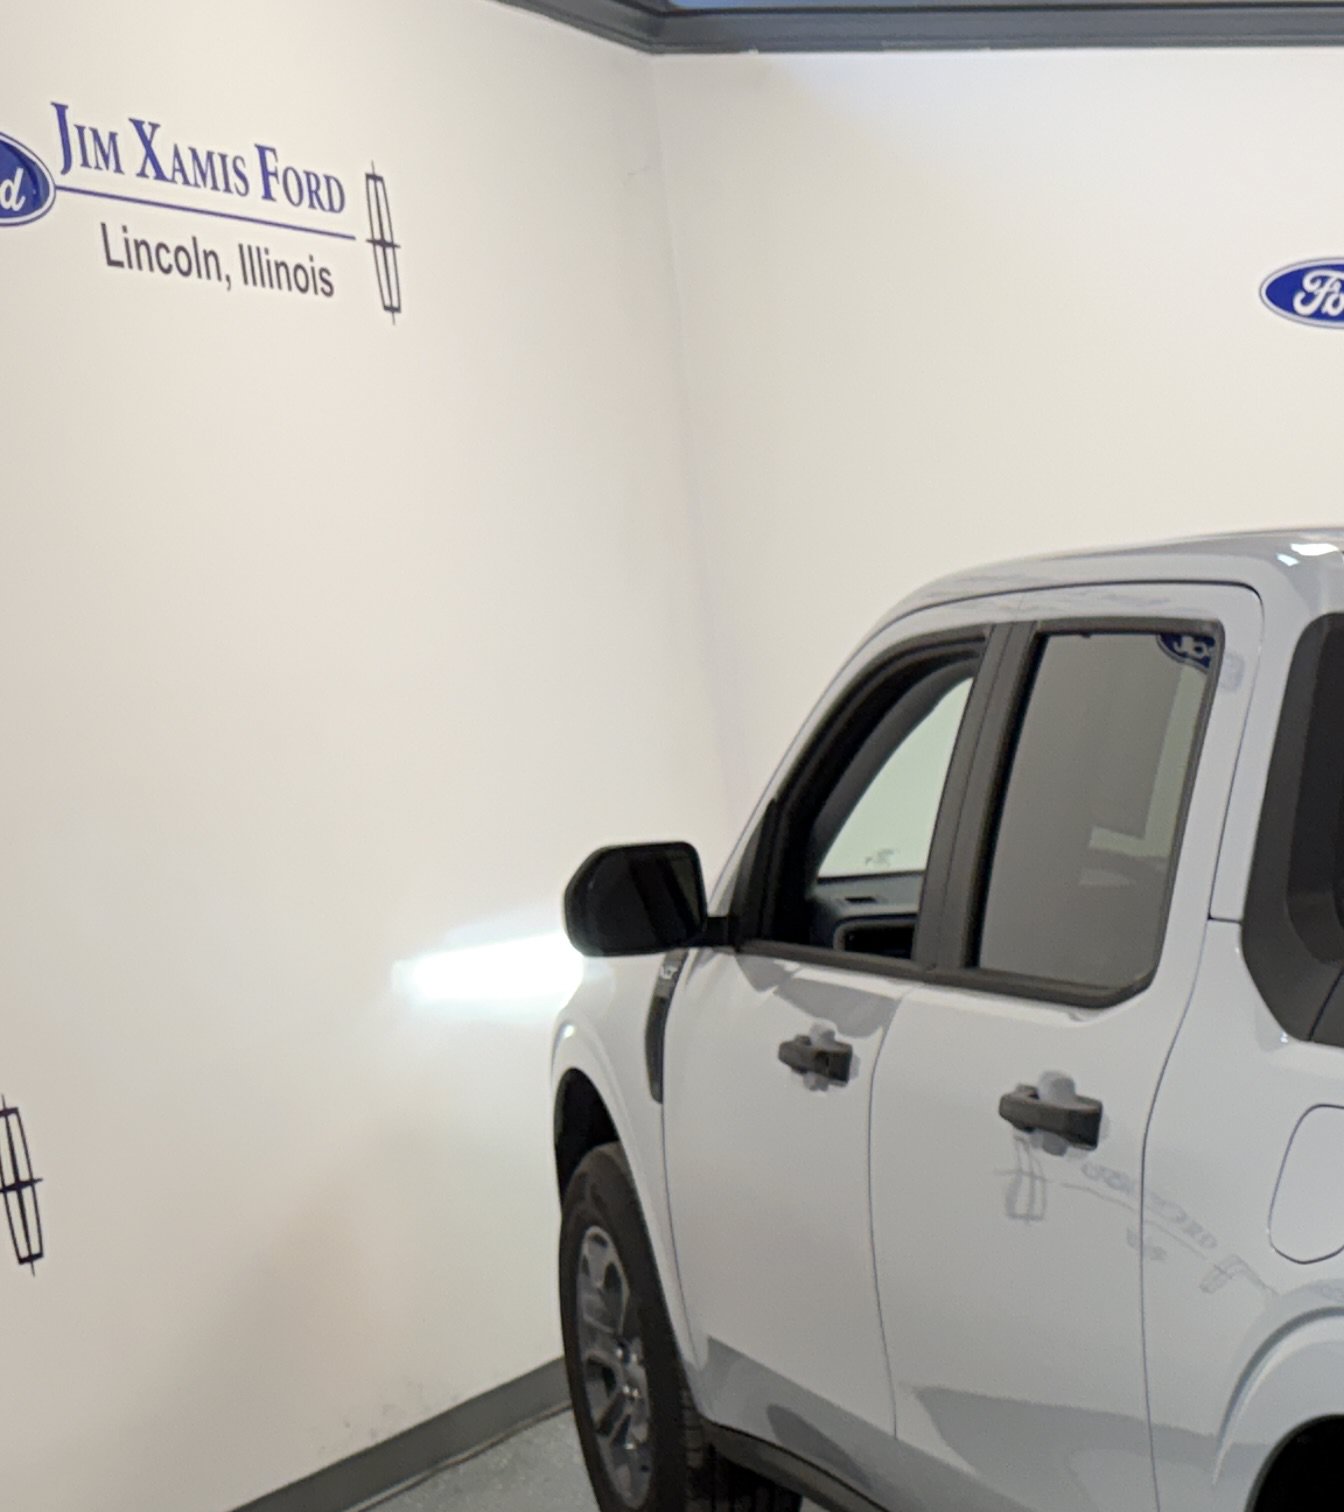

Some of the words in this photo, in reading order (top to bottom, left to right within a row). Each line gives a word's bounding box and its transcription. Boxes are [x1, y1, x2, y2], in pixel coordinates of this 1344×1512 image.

[51, 102, 124, 174] JIM
[127, 117, 249, 197] XAMIS
[255, 145, 344, 212] FORD
[101, 222, 232, 290] Lincoln,
[238, 243, 334, 297] Illinois
